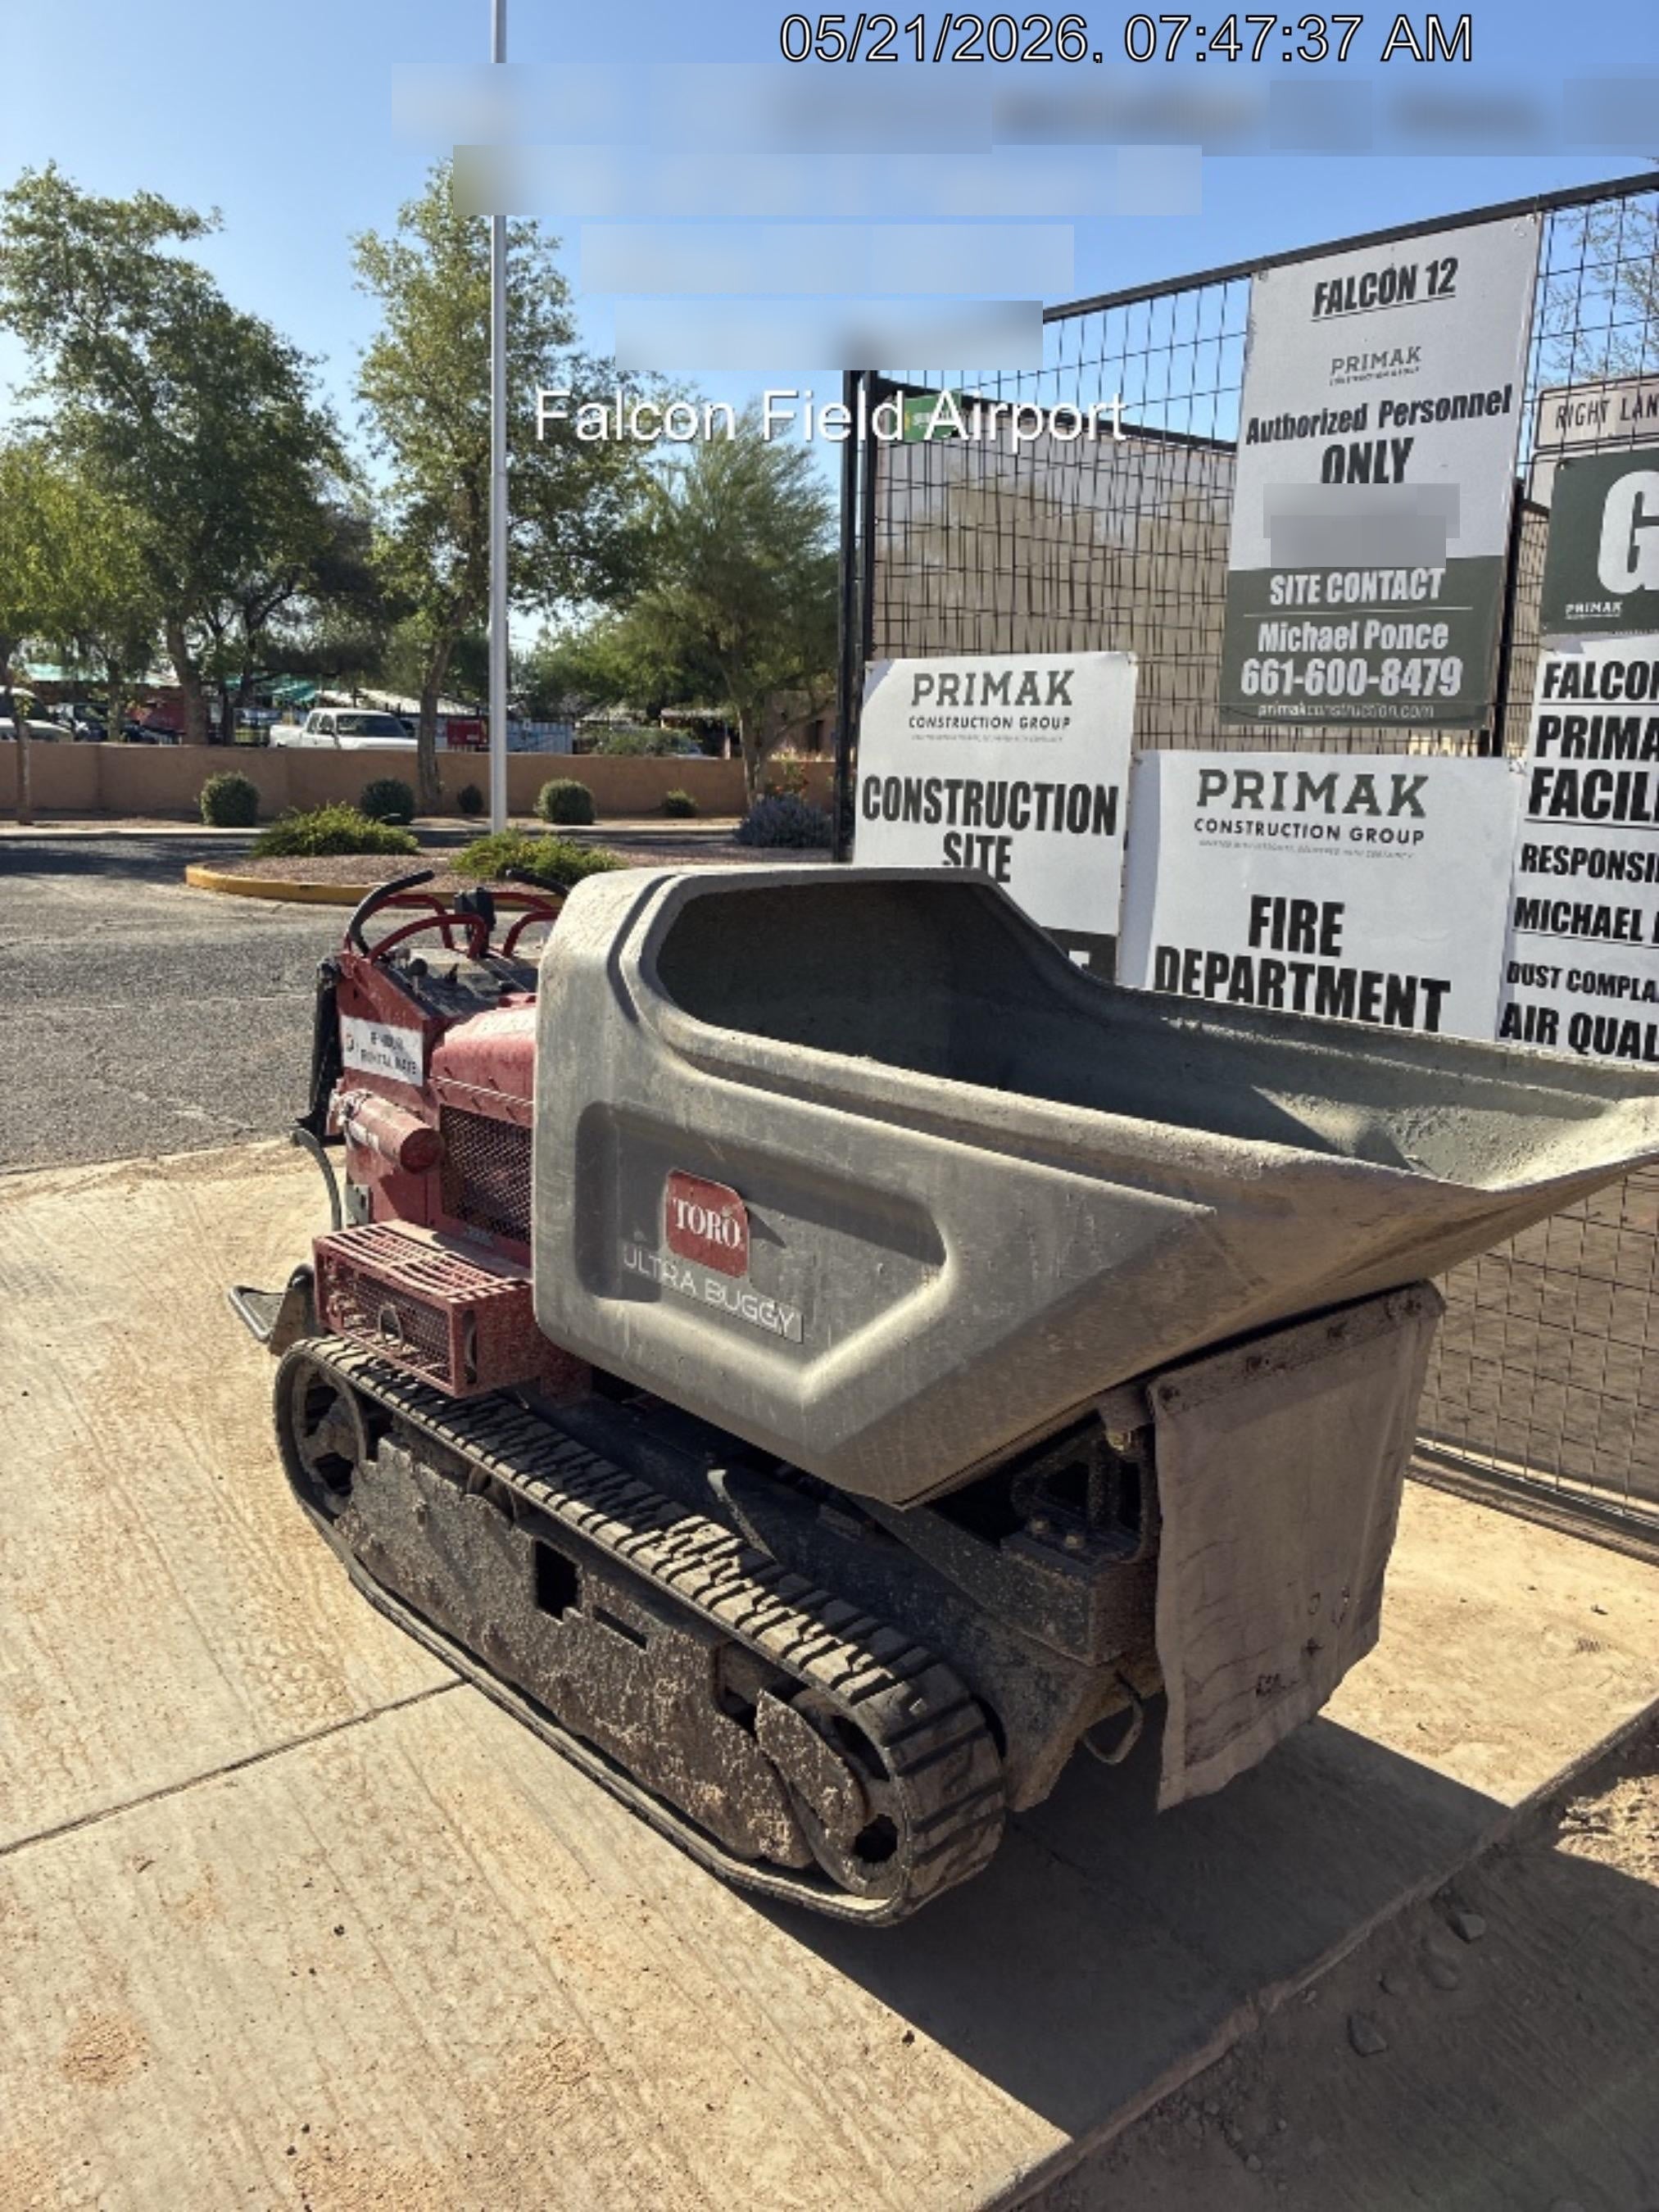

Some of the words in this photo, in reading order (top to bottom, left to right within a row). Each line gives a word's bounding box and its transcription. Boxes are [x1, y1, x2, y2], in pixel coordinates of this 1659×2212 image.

[1312, 264, 1419, 316] FALCON
[1425, 257, 1458, 296] 12
[1330, 347, 1421, 375] PRIMAK
[1246, 402, 1368, 445] Authorized
[1379, 383, 1512, 428] Personnel
[1556, 401, 1610, 429] RIGHT
[1321, 437, 1414, 483] ONLY
[1271, 574, 1320, 605] SITE
[1326, 568, 1446, 603] CONTACT
[1258, 621, 1360, 652] Michael
[1363, 619, 1448, 650] Ponce
[911, 671, 1075, 706] PRIMAK
[1240, 656, 1463, 696] 661-600-8479
[909, 714, 1013, 728] CONSTRUCTION
[1019, 715, 1072, 731] GROUP
[862, 775, 1119, 836] CONSTRUCTION
[1196, 768, 1429, 818] PRIMAK
[1529, 766, 1659, 823] FACIL
[1194, 818, 1341, 841] CONSTRUCTION
[1349, 827, 1425, 845] GROUP
[1521, 843, 1659, 883] RESPONSI
[1248, 895, 1344, 957] FIRE
[1514, 896, 1643, 941] MICHAEL
[1155, 945, 1451, 1032] DEPARTMENT
[1507, 960, 1563, 989] DUST
[1499, 1002, 1560, 1045] AIR
[673, 1198, 741, 1249] TORO
[623, 1244, 698, 1296] ULTRA
[705, 1277, 796, 1339] BUGGY
